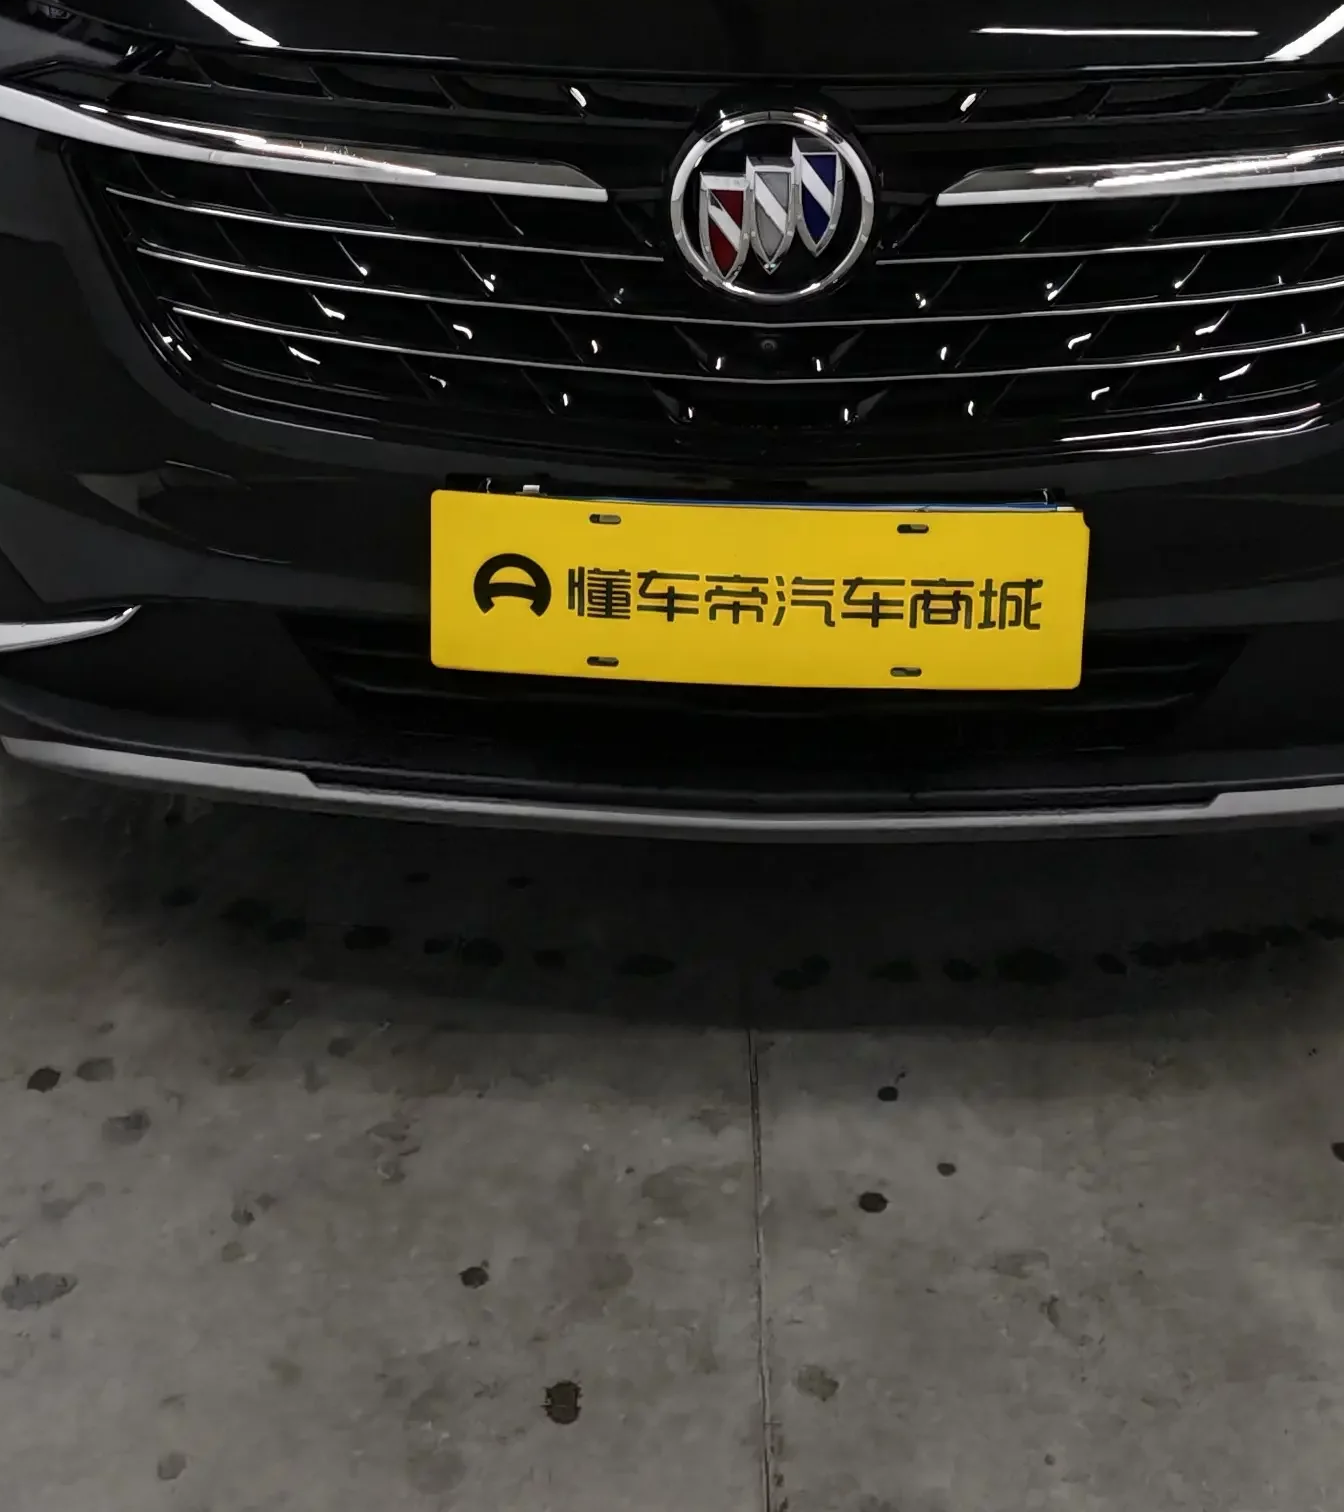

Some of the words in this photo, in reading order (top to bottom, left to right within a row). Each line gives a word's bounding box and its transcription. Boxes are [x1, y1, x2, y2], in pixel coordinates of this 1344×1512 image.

[567, 565, 1043, 631] 懂车帝汽车商城
